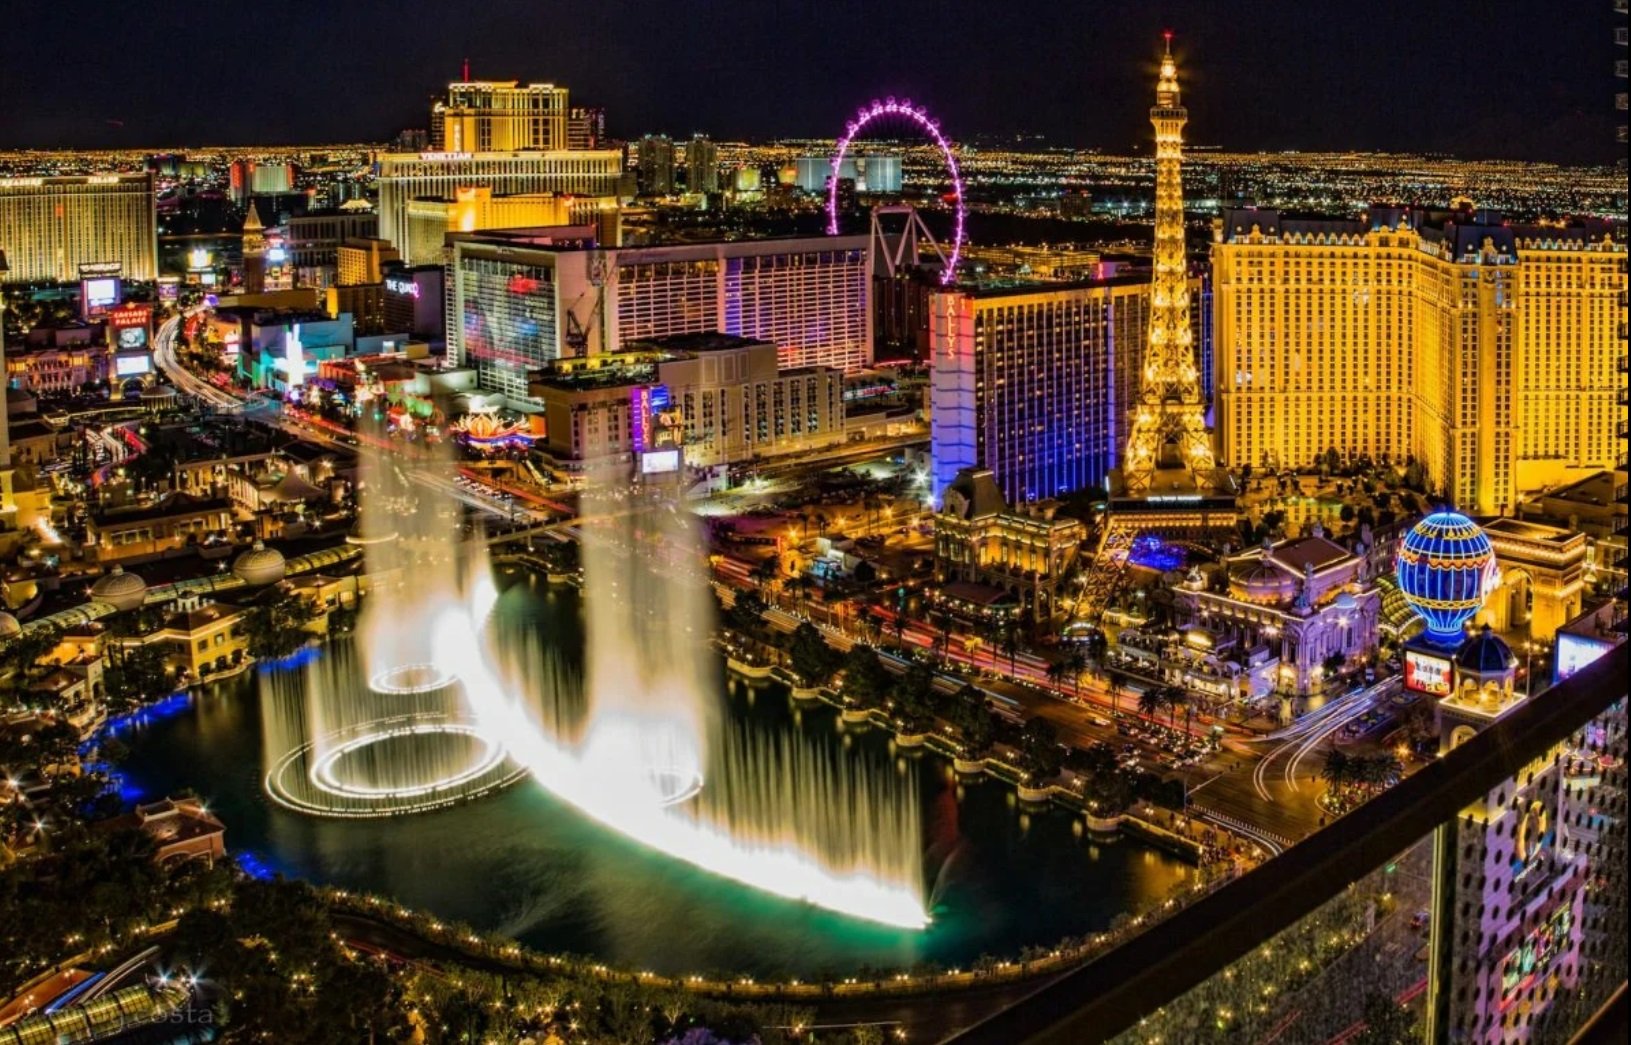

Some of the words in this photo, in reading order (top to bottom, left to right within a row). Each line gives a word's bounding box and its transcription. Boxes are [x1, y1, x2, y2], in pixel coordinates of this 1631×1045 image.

[385, 280, 397, 291] THE
[113, 310, 147, 318] CAESARS
[115, 317, 146, 325] PALACE
